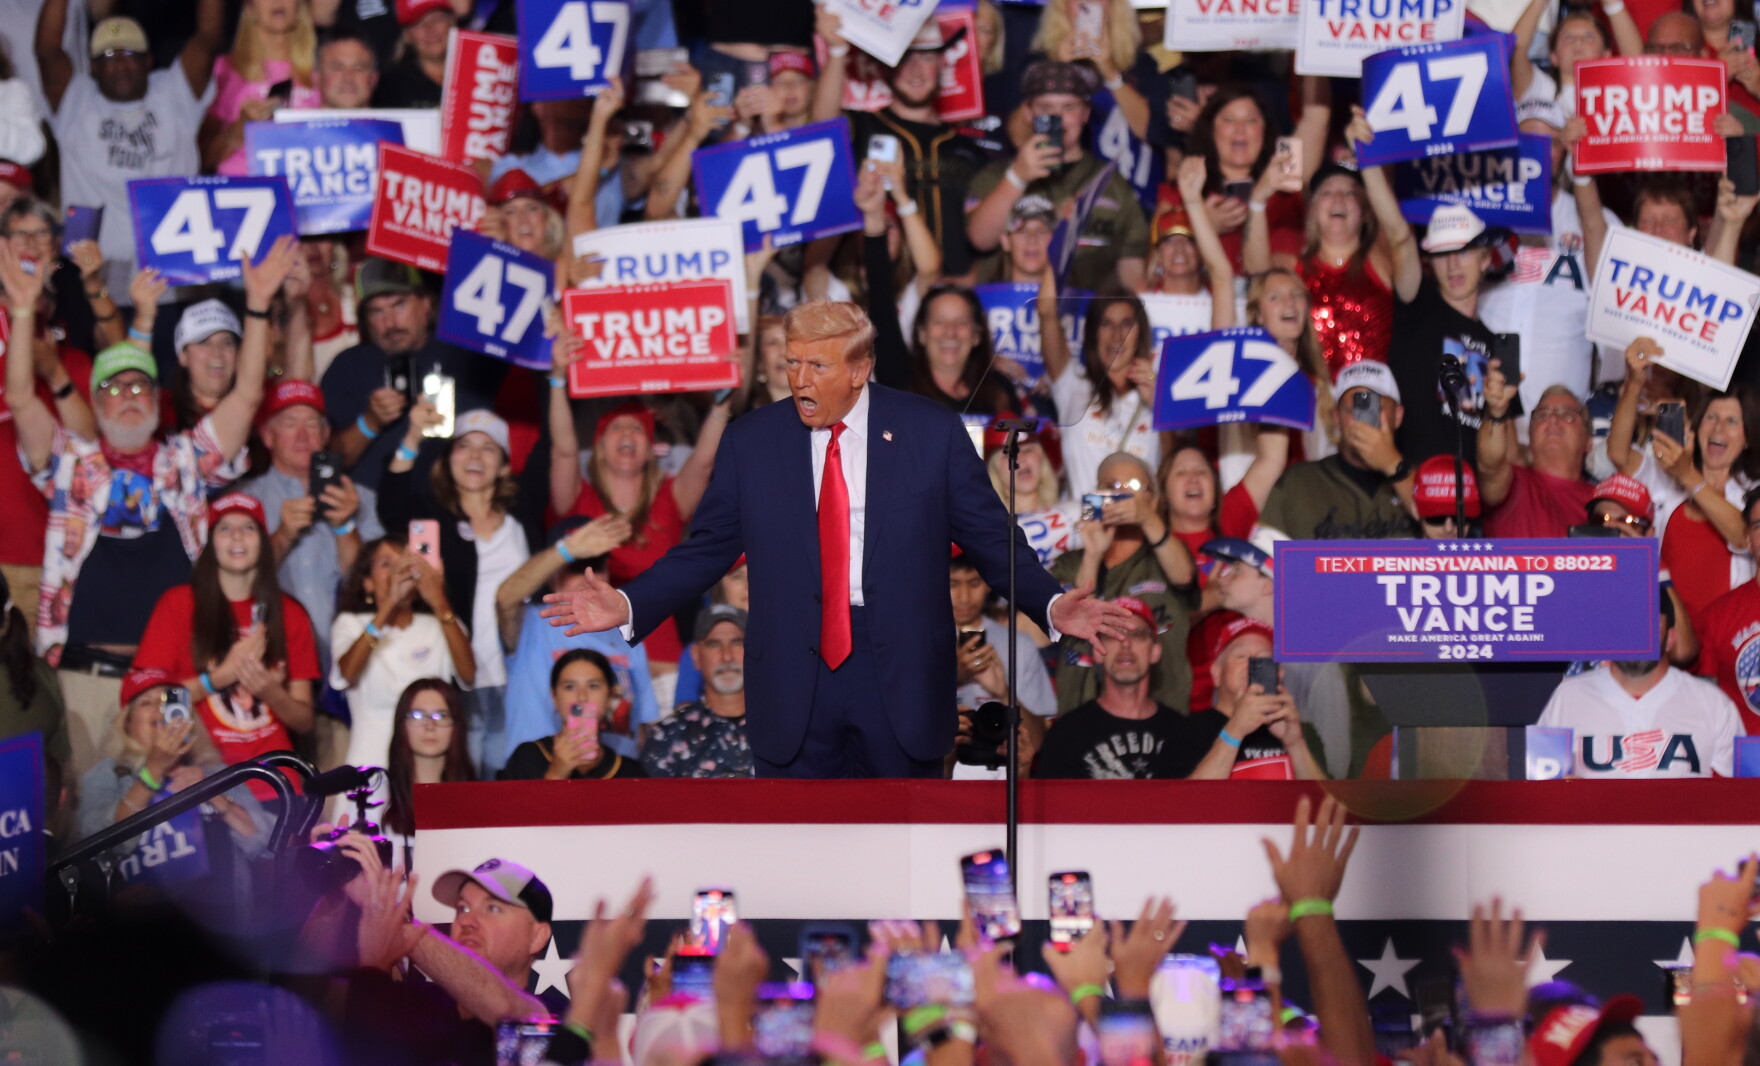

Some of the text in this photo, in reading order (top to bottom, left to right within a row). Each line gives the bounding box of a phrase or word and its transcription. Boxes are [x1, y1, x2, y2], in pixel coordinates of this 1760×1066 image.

[1316, 0, 1453, 19] TRUMP
[533, 0, 630, 80] 47
[1327, 21, 1436, 40] VANCE
[463, 43, 499, 166] RUMP
[1366, 52, 1489, 142] 47
[1580, 84, 1720, 116] TRUMP
[1594, 110, 1706, 136] VANCE
[256, 142, 379, 177] TRUM
[286, 171, 379, 198] ANC
[383, 169, 488, 224] TRUMP
[715, 138, 836, 233] 47
[150, 187, 277, 265] 47
[453, 253, 547, 344] 47
[1610, 257, 1744, 324] TRUMP
[574, 306, 725, 340] TRUMP
[1616, 287, 1720, 344] VANCE
[592, 333, 712, 359] VANCE
[1170, 339, 1299, 409] 47
[1320, 555, 1613, 572] TEXT PENNSYLVANIA TO 88022
[1377, 574, 1555, 606] TRUMP
[1397, 606, 1534, 632] VANCE
[1388, 633, 1545, 643] MAKE AMERICA GREAT AGAIN!
[1438, 644, 1494, 660] 2024
[1577, 728, 1701, 774] USA
